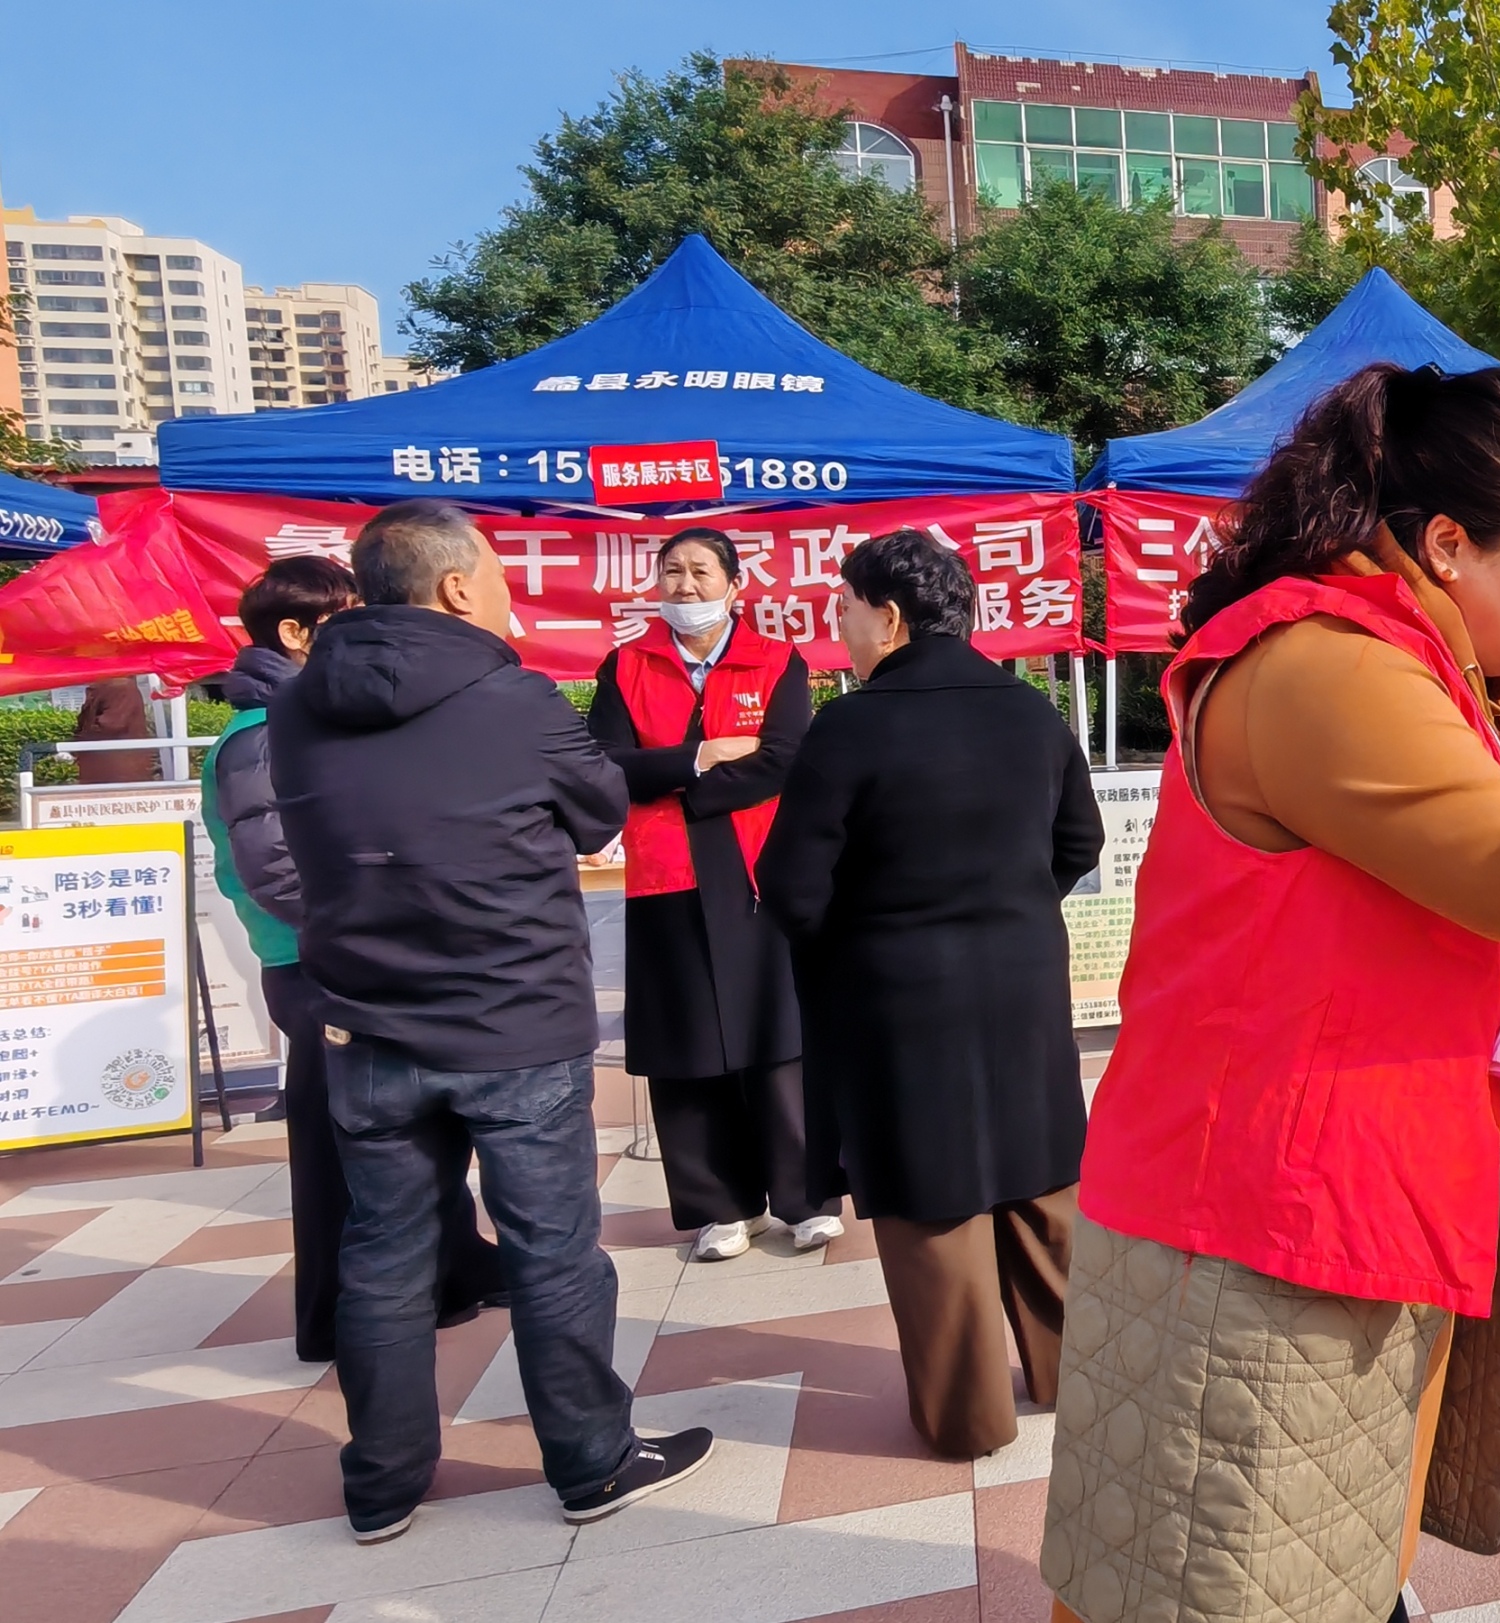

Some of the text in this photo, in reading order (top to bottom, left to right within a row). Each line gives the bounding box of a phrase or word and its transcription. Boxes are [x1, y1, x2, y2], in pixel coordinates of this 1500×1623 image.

[531, 370, 825, 393] 蠡县永明眼镜
[602, 458, 714, 487] 服务展示专区
[54, 867, 171, 892] 陪诊是啥?
[63, 896, 163, 919] 3秒看懂!
